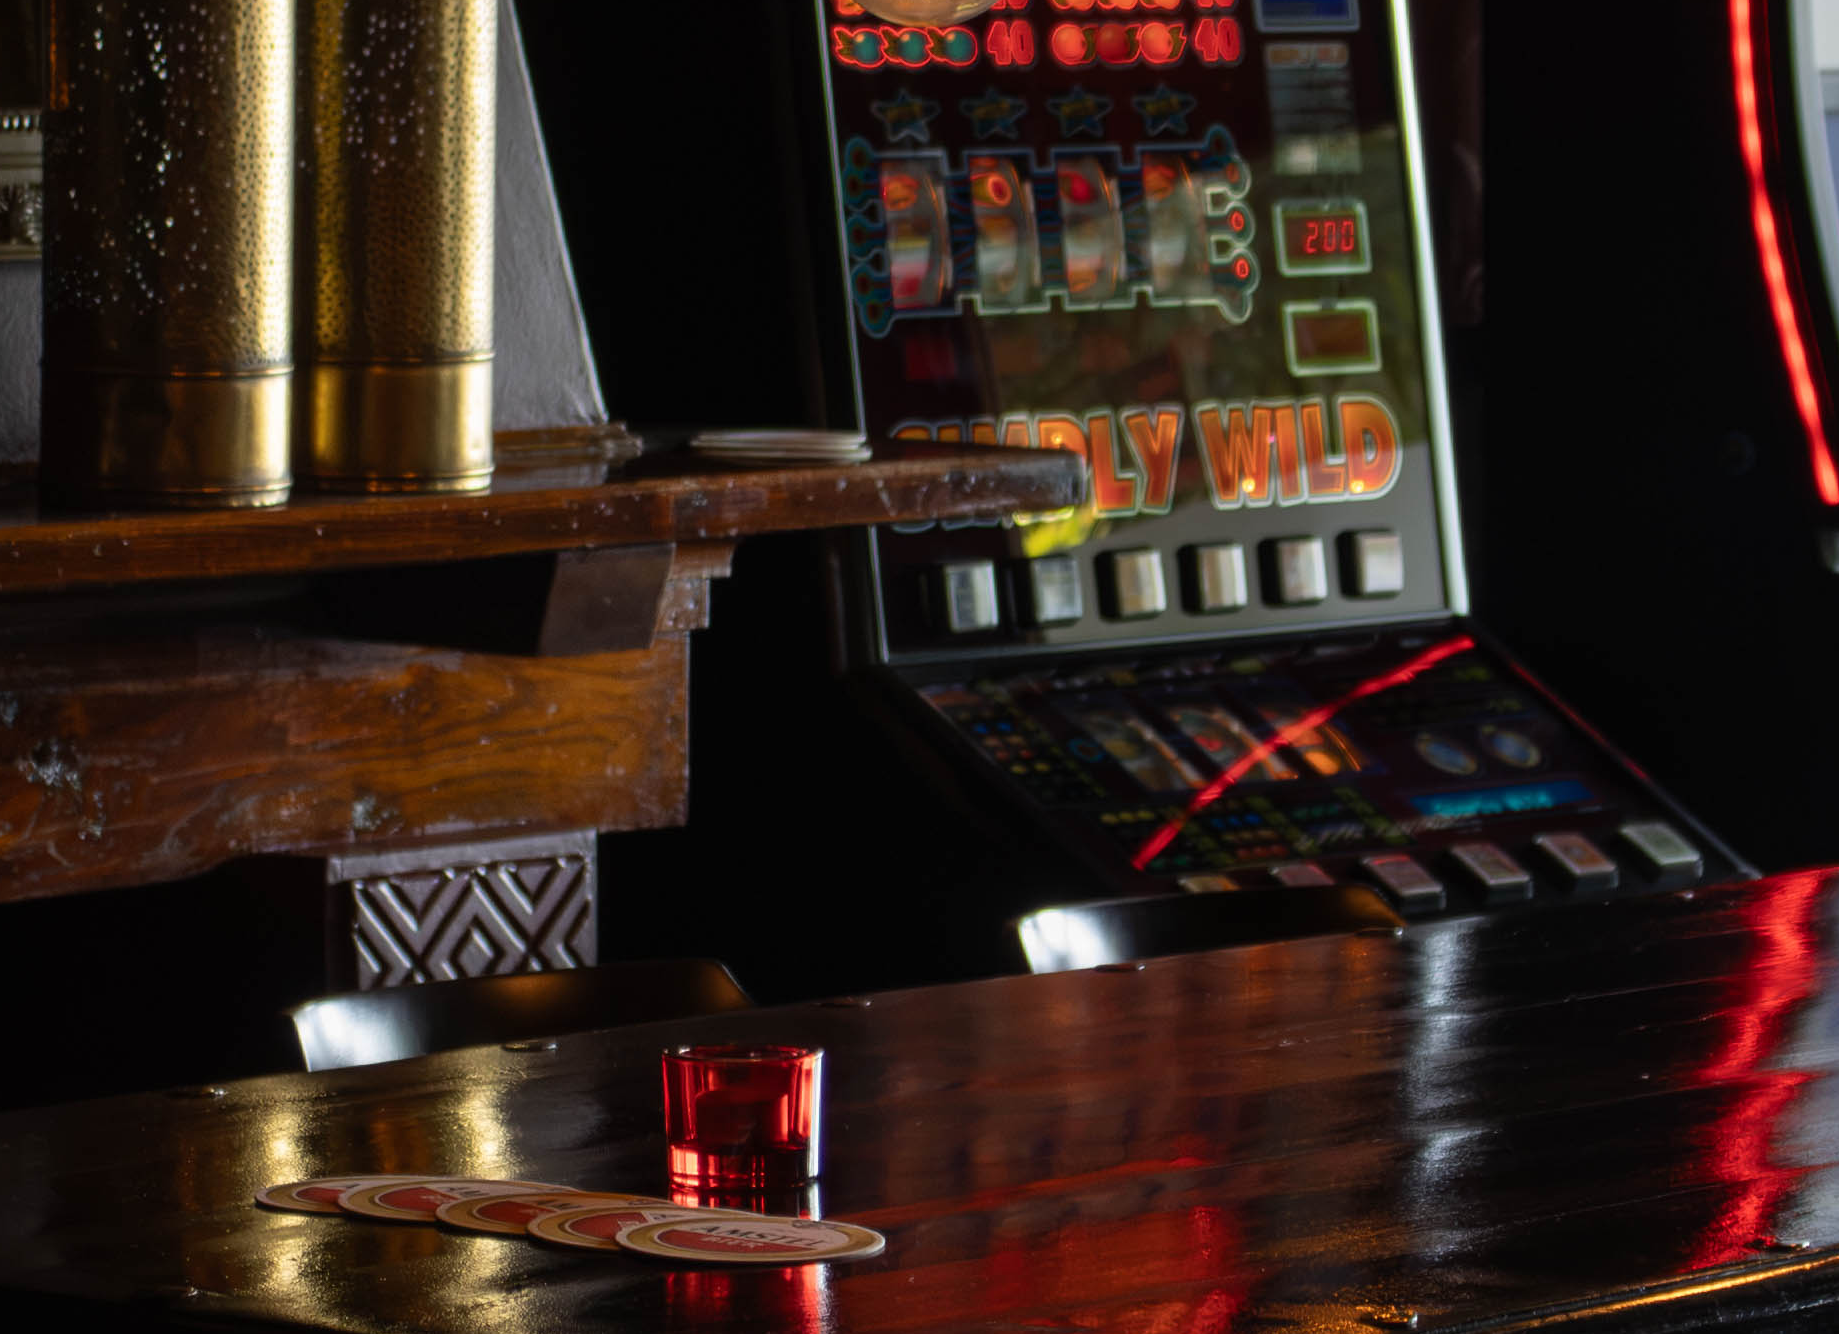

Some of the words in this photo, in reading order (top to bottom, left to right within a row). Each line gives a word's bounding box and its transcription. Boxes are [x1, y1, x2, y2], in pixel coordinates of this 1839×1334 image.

[986, 19, 1034, 66] 40
[1194, 17, 1241, 63] 40
[1304, 221, 1355, 253] 200
[1195, 394, 1403, 511] WILD
[694, 1224, 828, 1247] AMSTEL
